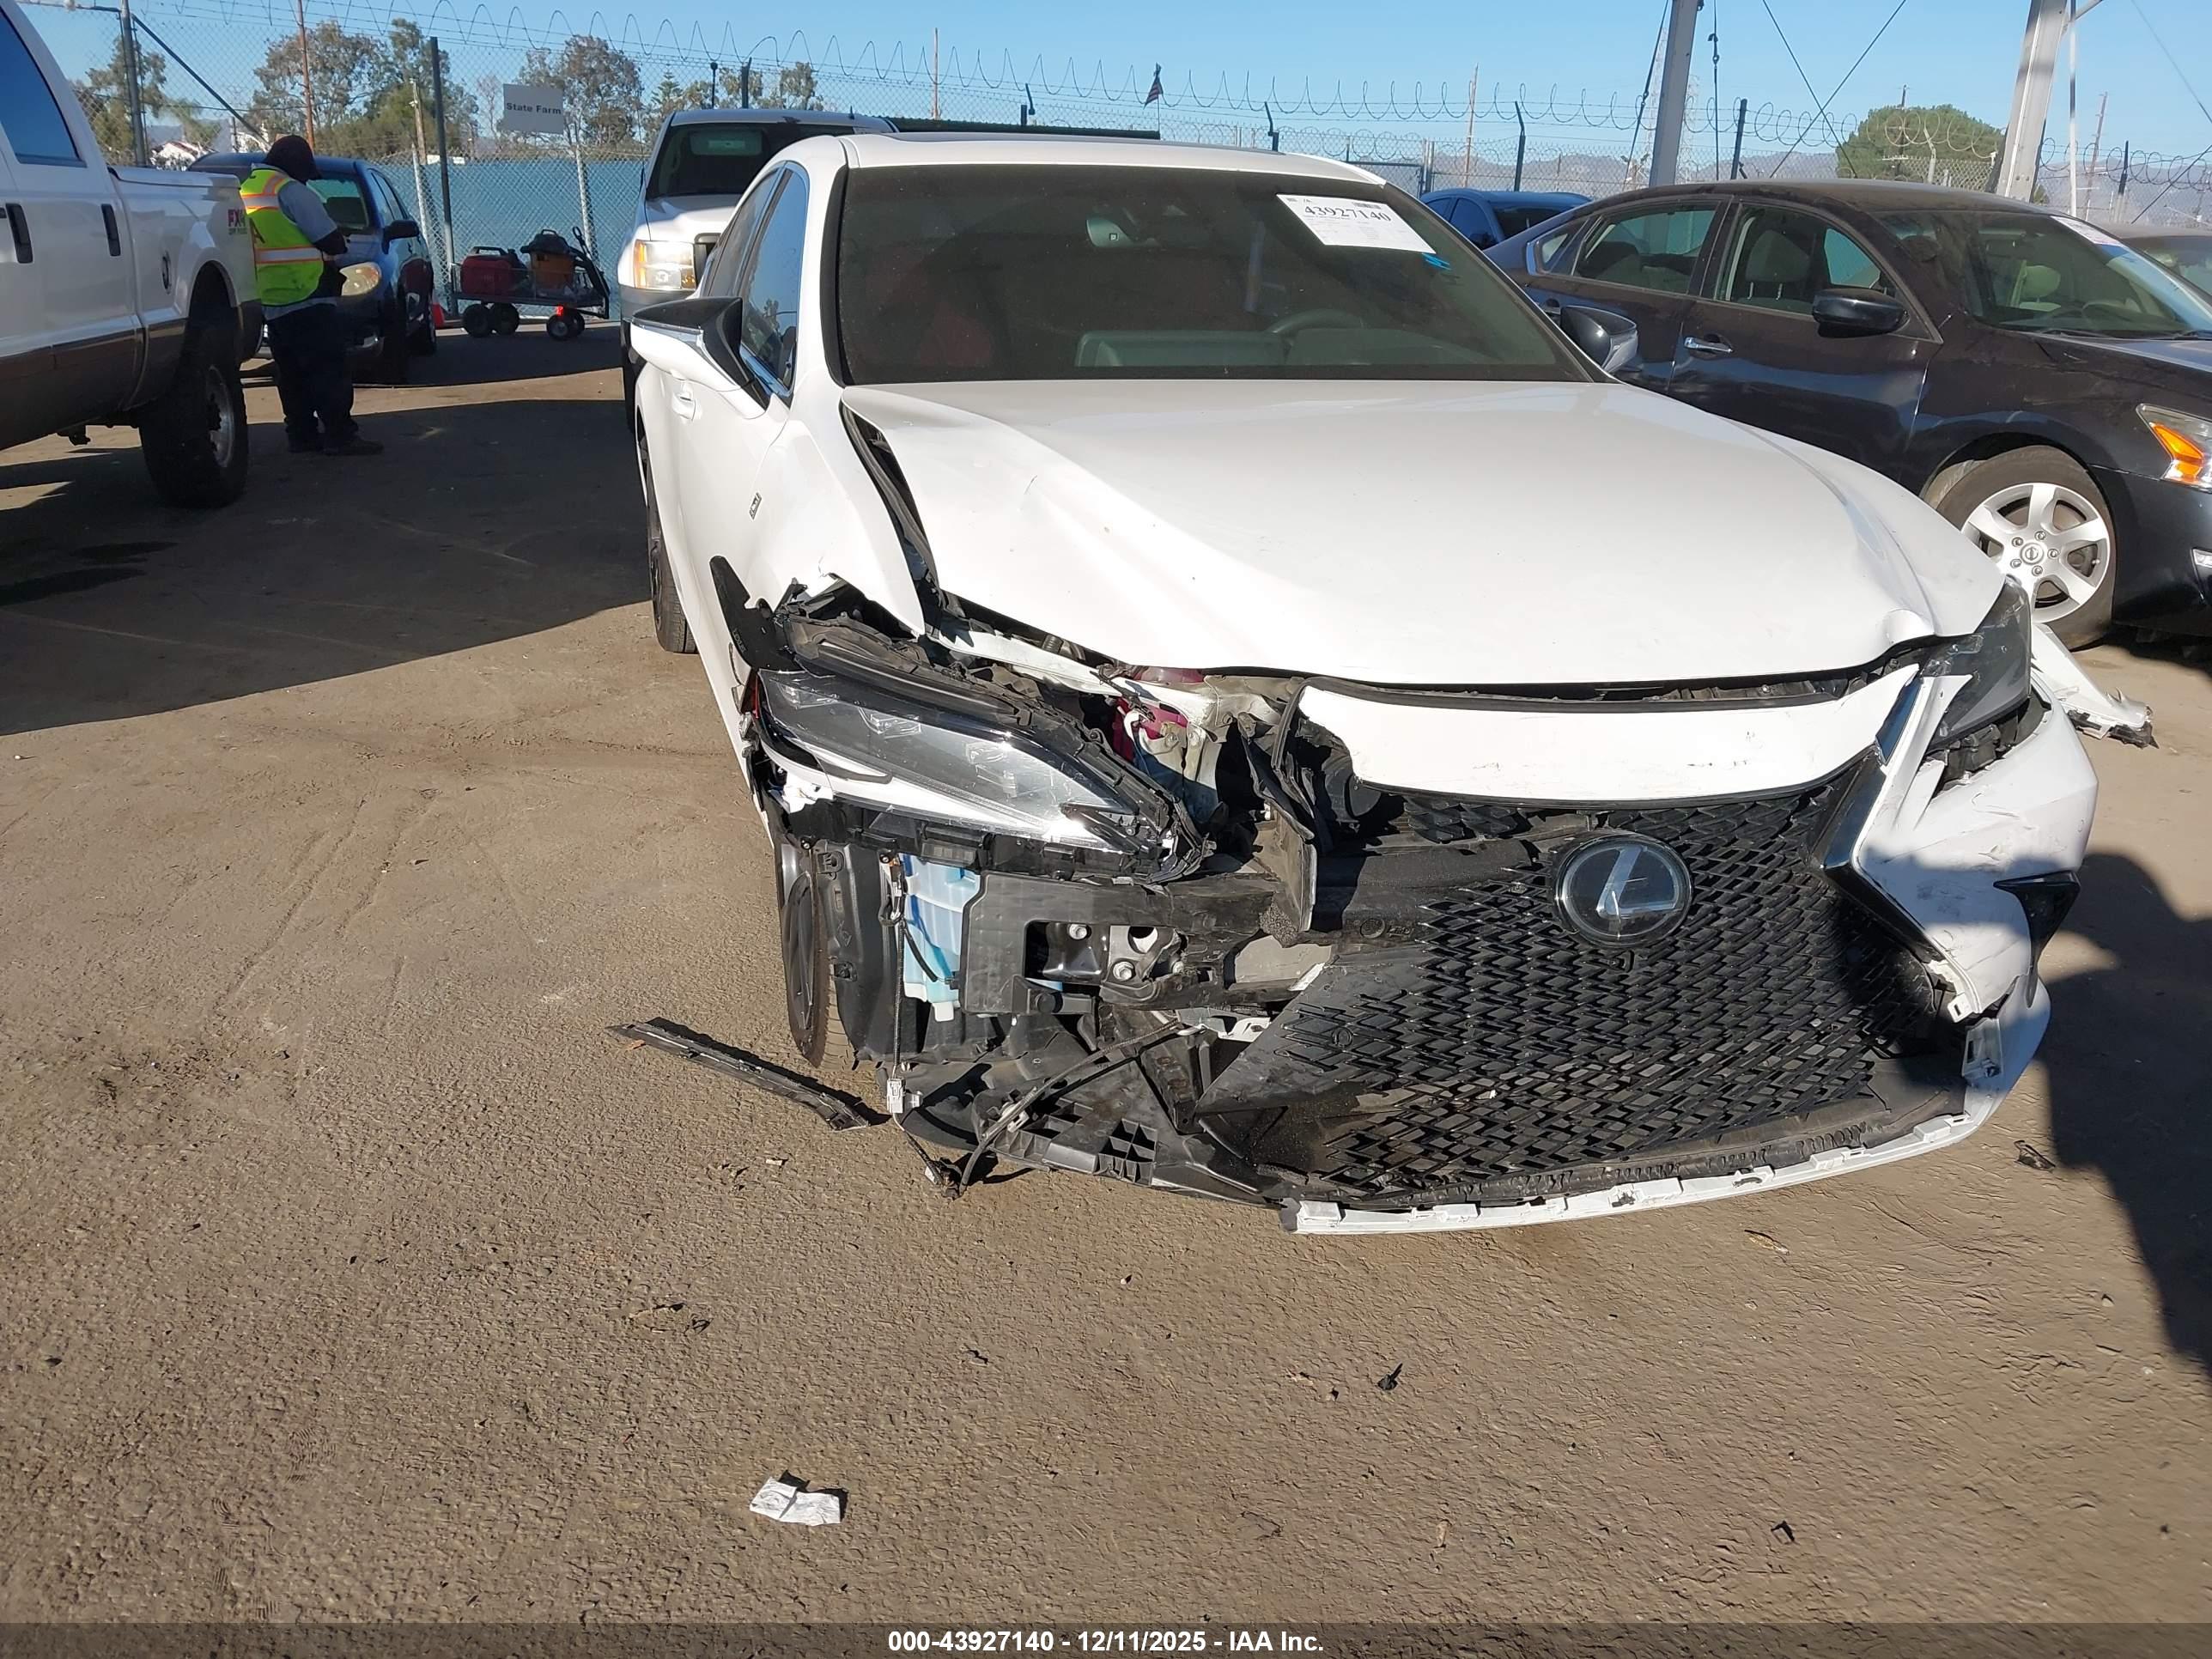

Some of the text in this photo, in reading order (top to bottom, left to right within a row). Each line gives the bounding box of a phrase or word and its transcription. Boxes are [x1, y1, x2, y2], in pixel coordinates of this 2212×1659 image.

[507, 102, 562, 115] State Farm
[1304, 205, 1392, 222] 43927140
